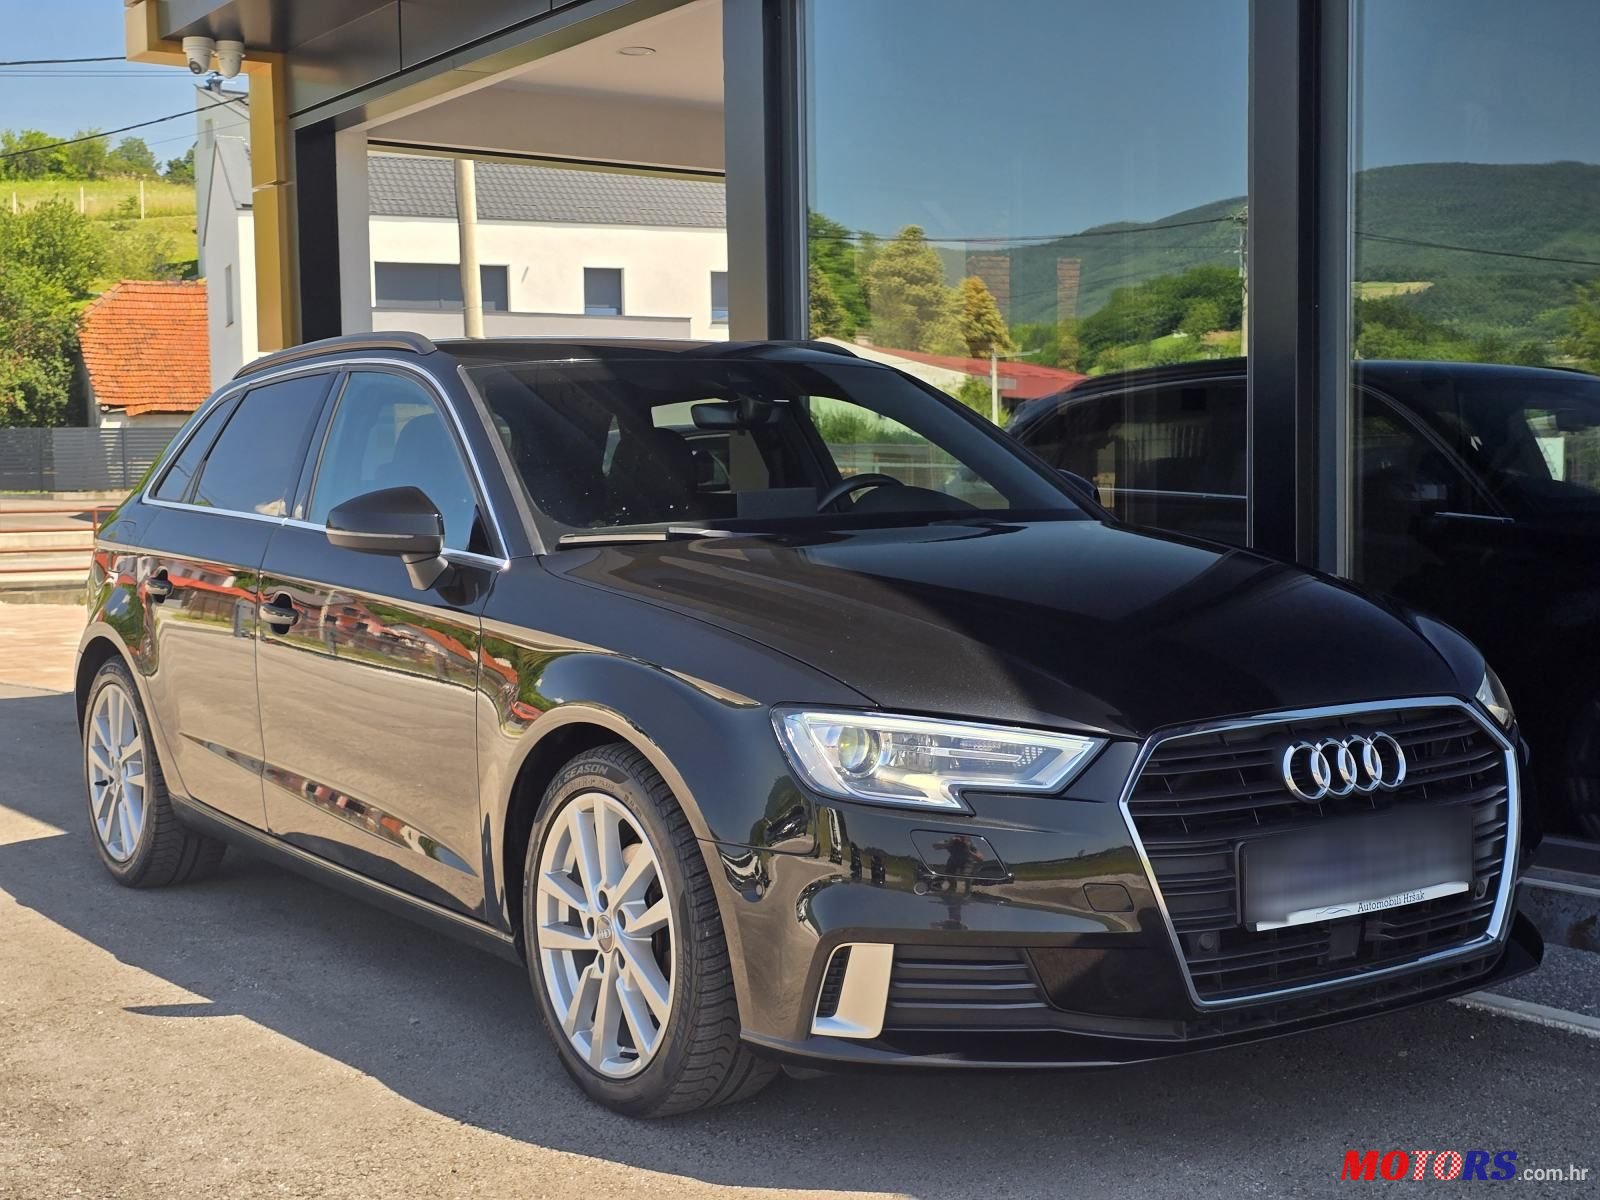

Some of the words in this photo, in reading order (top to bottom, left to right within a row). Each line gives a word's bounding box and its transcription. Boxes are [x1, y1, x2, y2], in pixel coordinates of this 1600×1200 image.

[563, 763, 609, 783] SEASON
[1357, 895, 1401, 912] Automobili
[1403, 890, 1425, 904] Hršak
